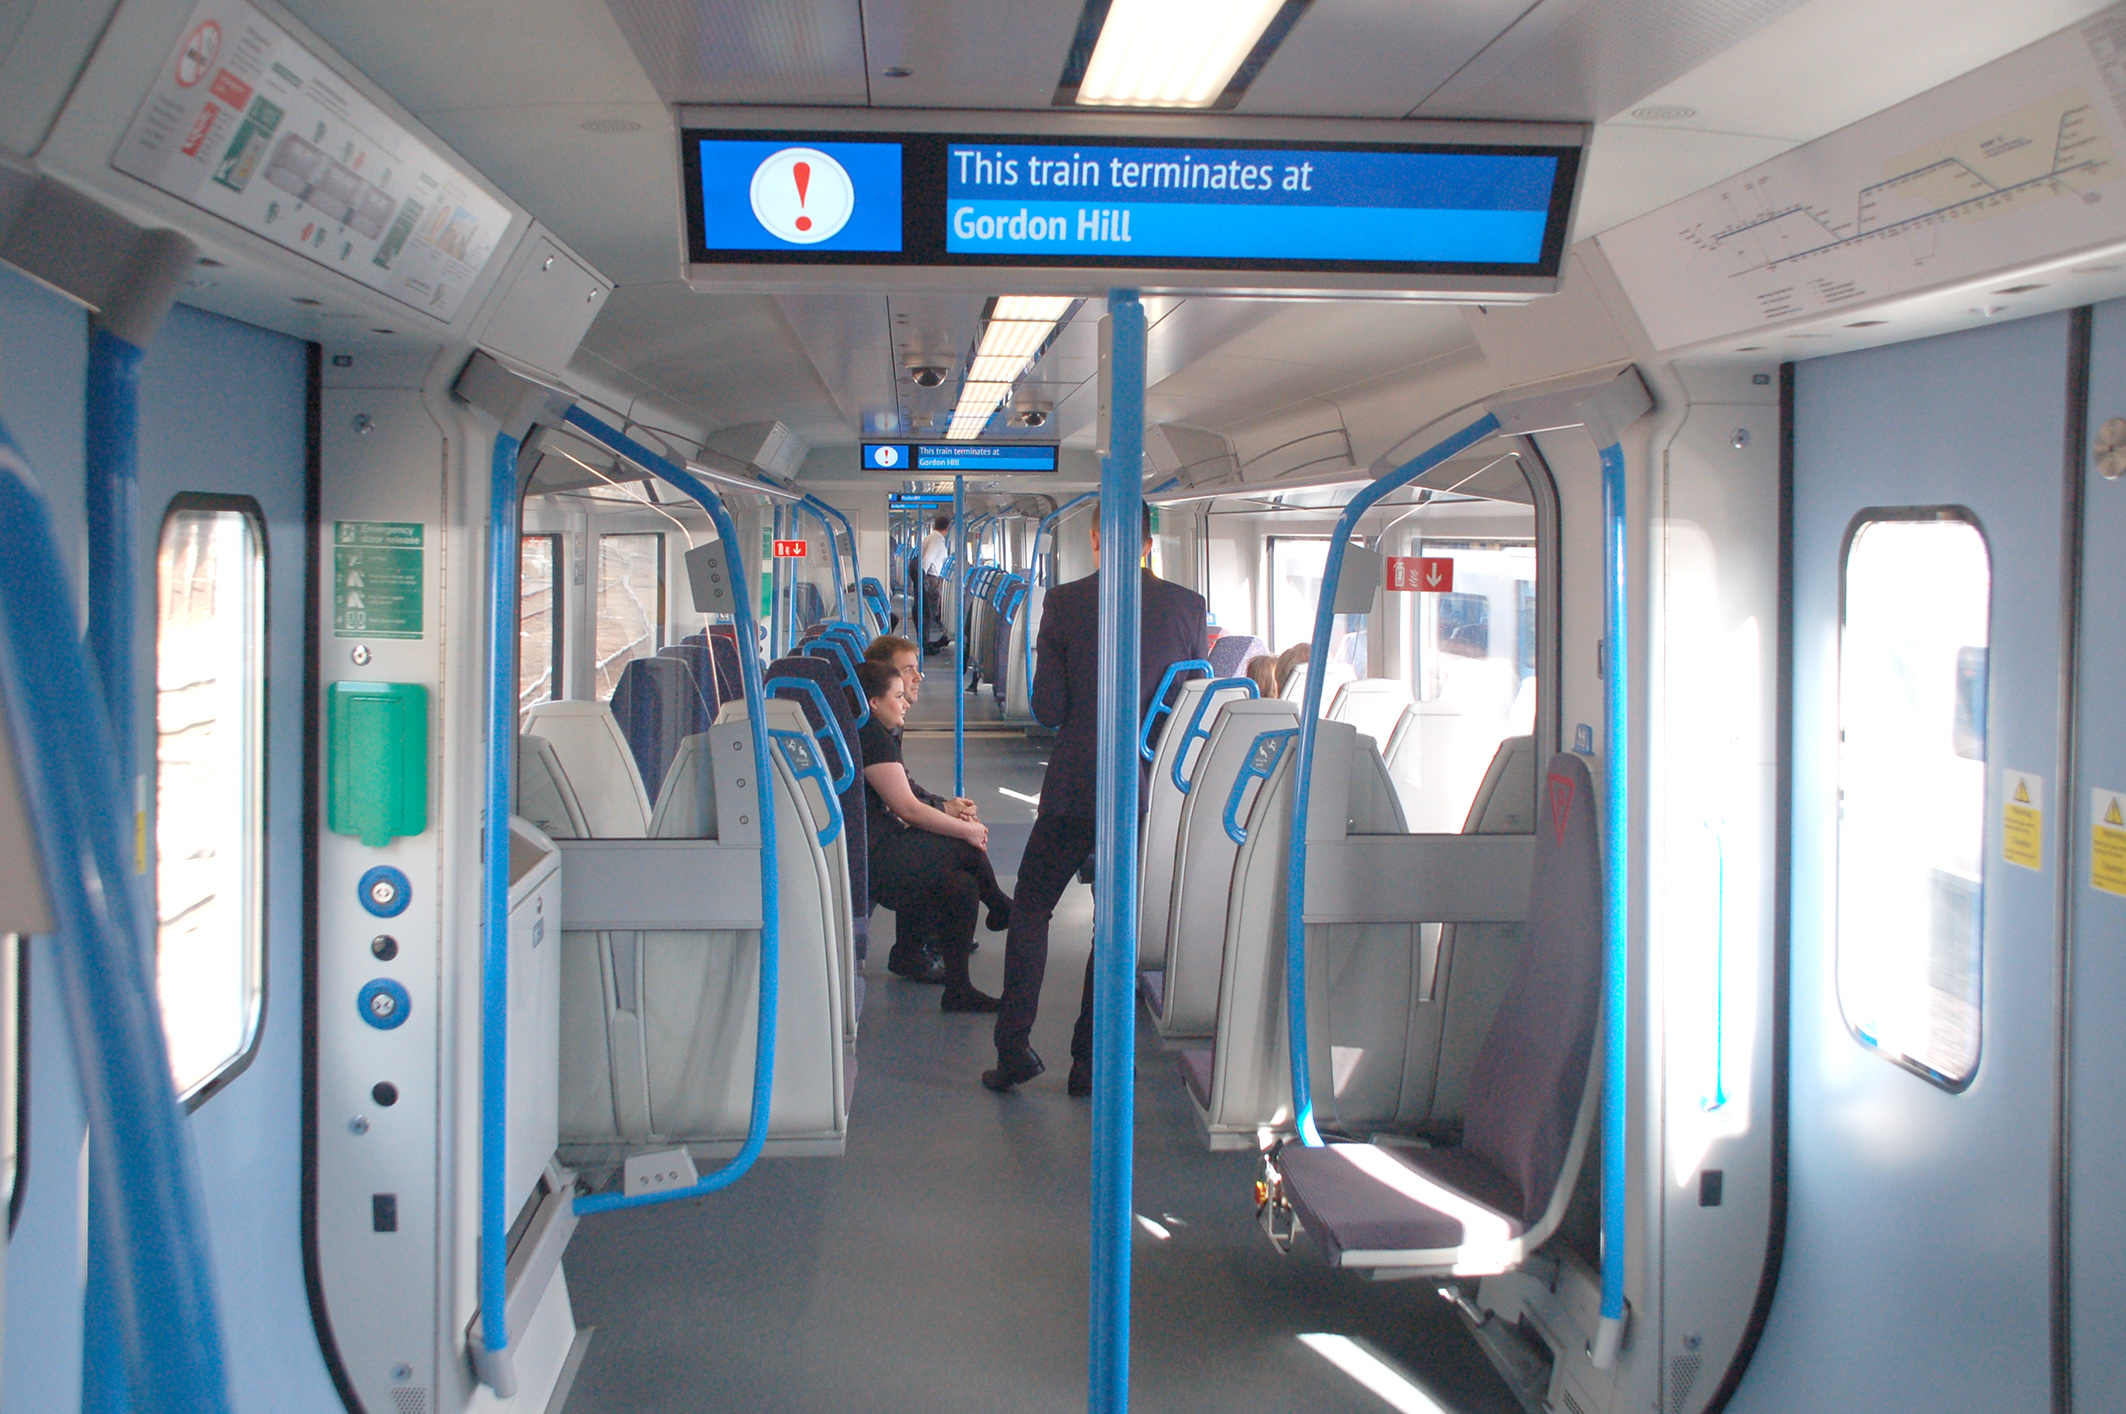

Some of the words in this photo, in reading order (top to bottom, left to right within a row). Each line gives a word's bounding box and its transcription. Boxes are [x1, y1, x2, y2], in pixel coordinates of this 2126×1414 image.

[954, 151, 1018, 186] This
[1028, 153, 1100, 187] train
[1110, 155, 1273, 190] terminates
[1282, 161, 1313, 191] at
[954, 206, 1067, 240] Gordon
[1077, 208, 1132, 242] Hill
[919, 447, 934, 455] This
[936, 447, 953, 455] train
[954, 448, 991, 456] terminates
[992, 448, 1000, 456] at
[919, 458, 946, 466] Gordon
[946, 458, 960, 466] Hill
[360, 525, 415, 536] Emergency
